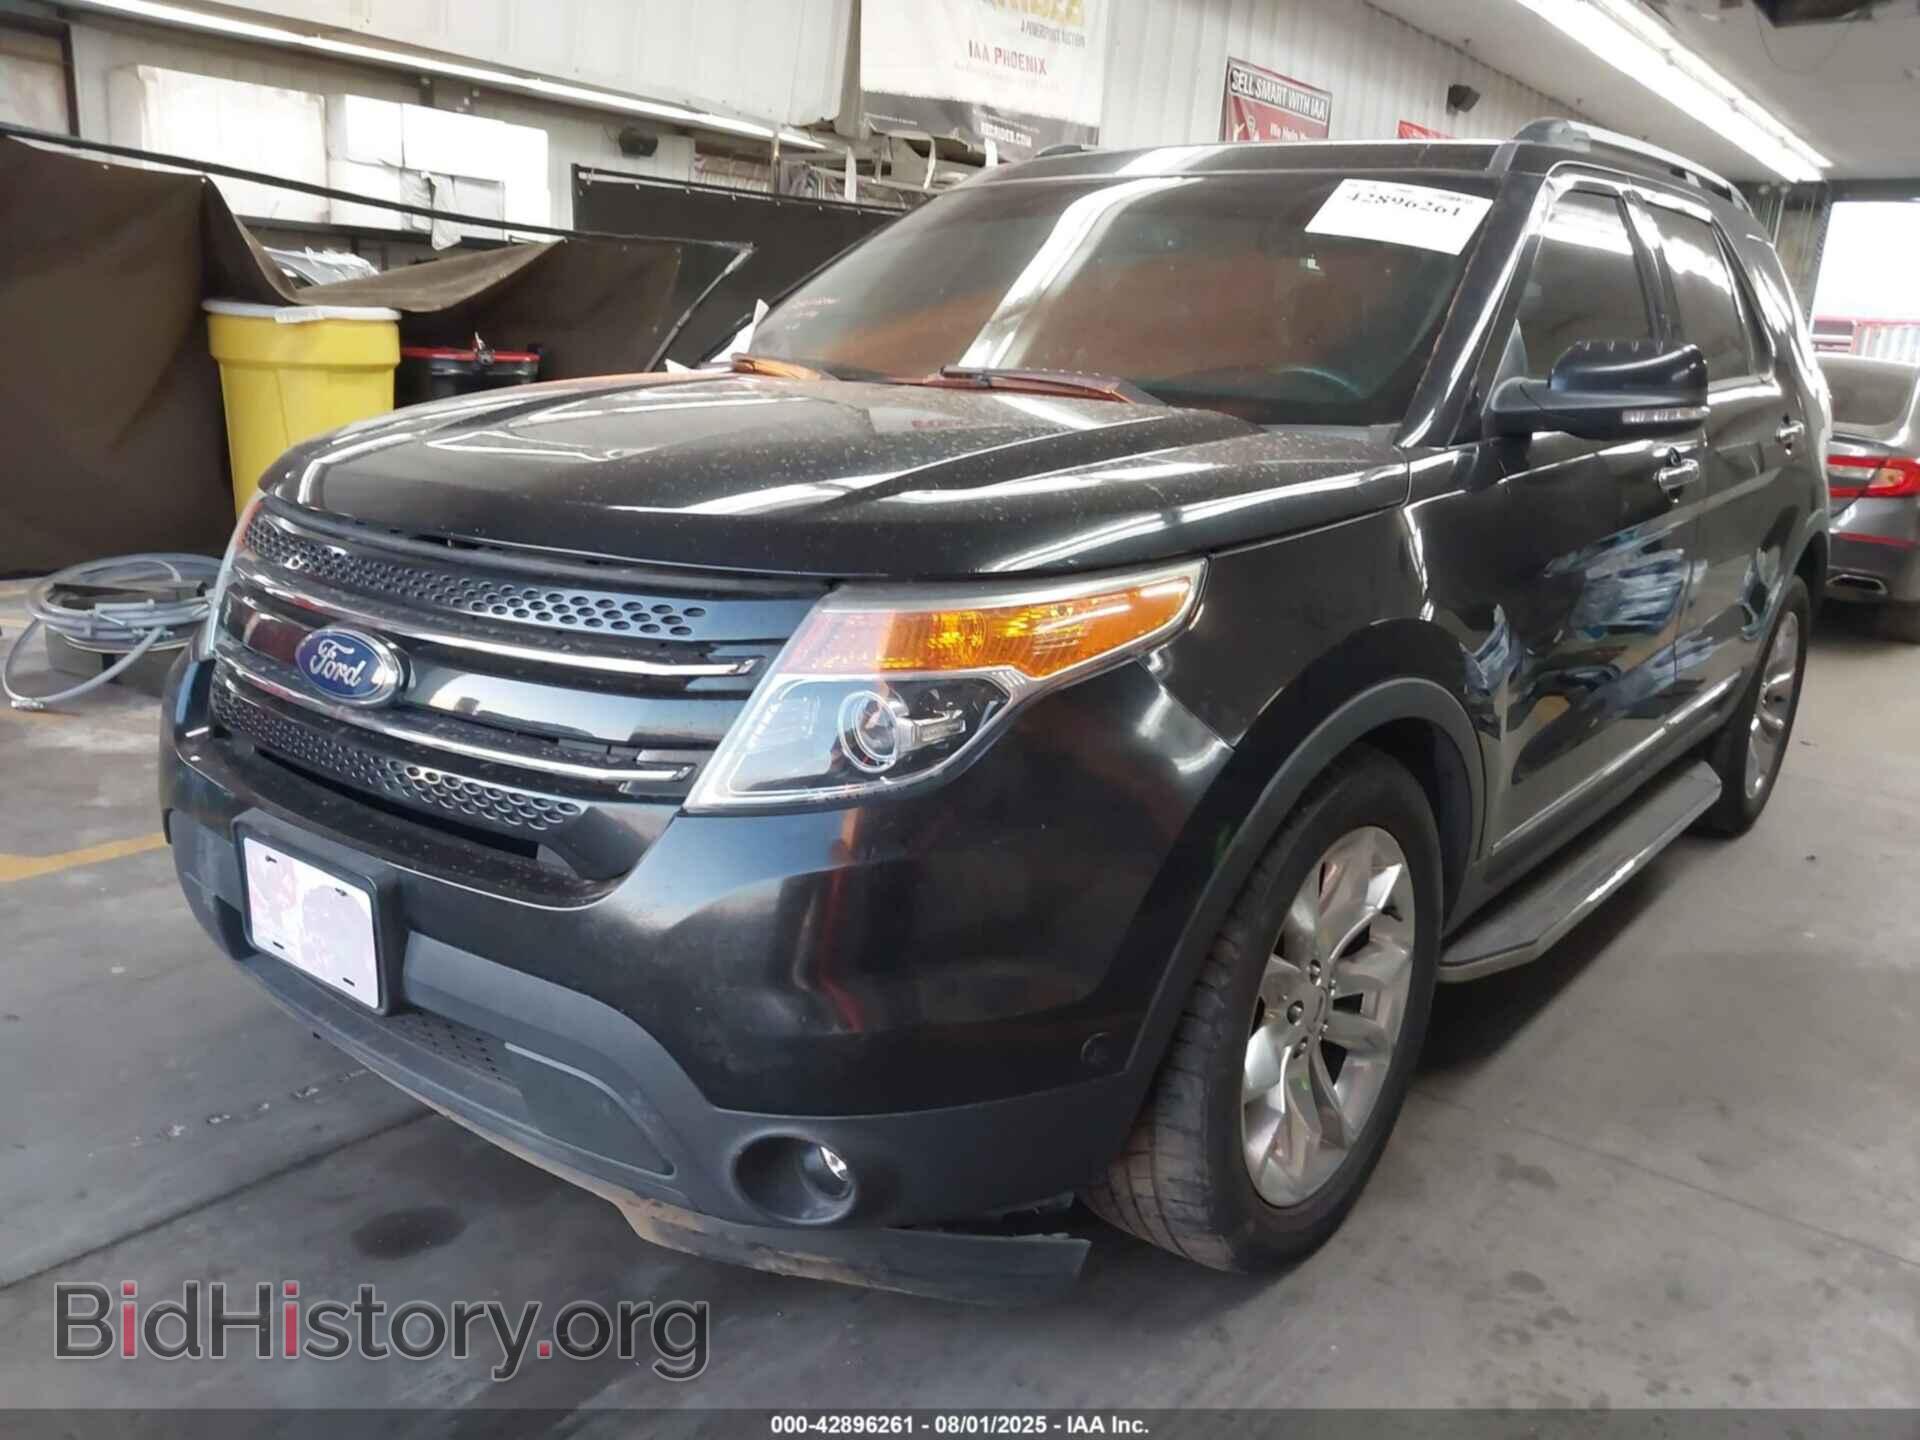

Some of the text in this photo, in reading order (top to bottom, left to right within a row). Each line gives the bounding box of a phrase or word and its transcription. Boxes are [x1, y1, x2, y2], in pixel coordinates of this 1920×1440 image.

[969, 39, 1048, 75] IAA PHOENIX
[1231, 69, 1326, 120] SELL SMART WITH IAA
[309, 639, 367, 687] Ford
